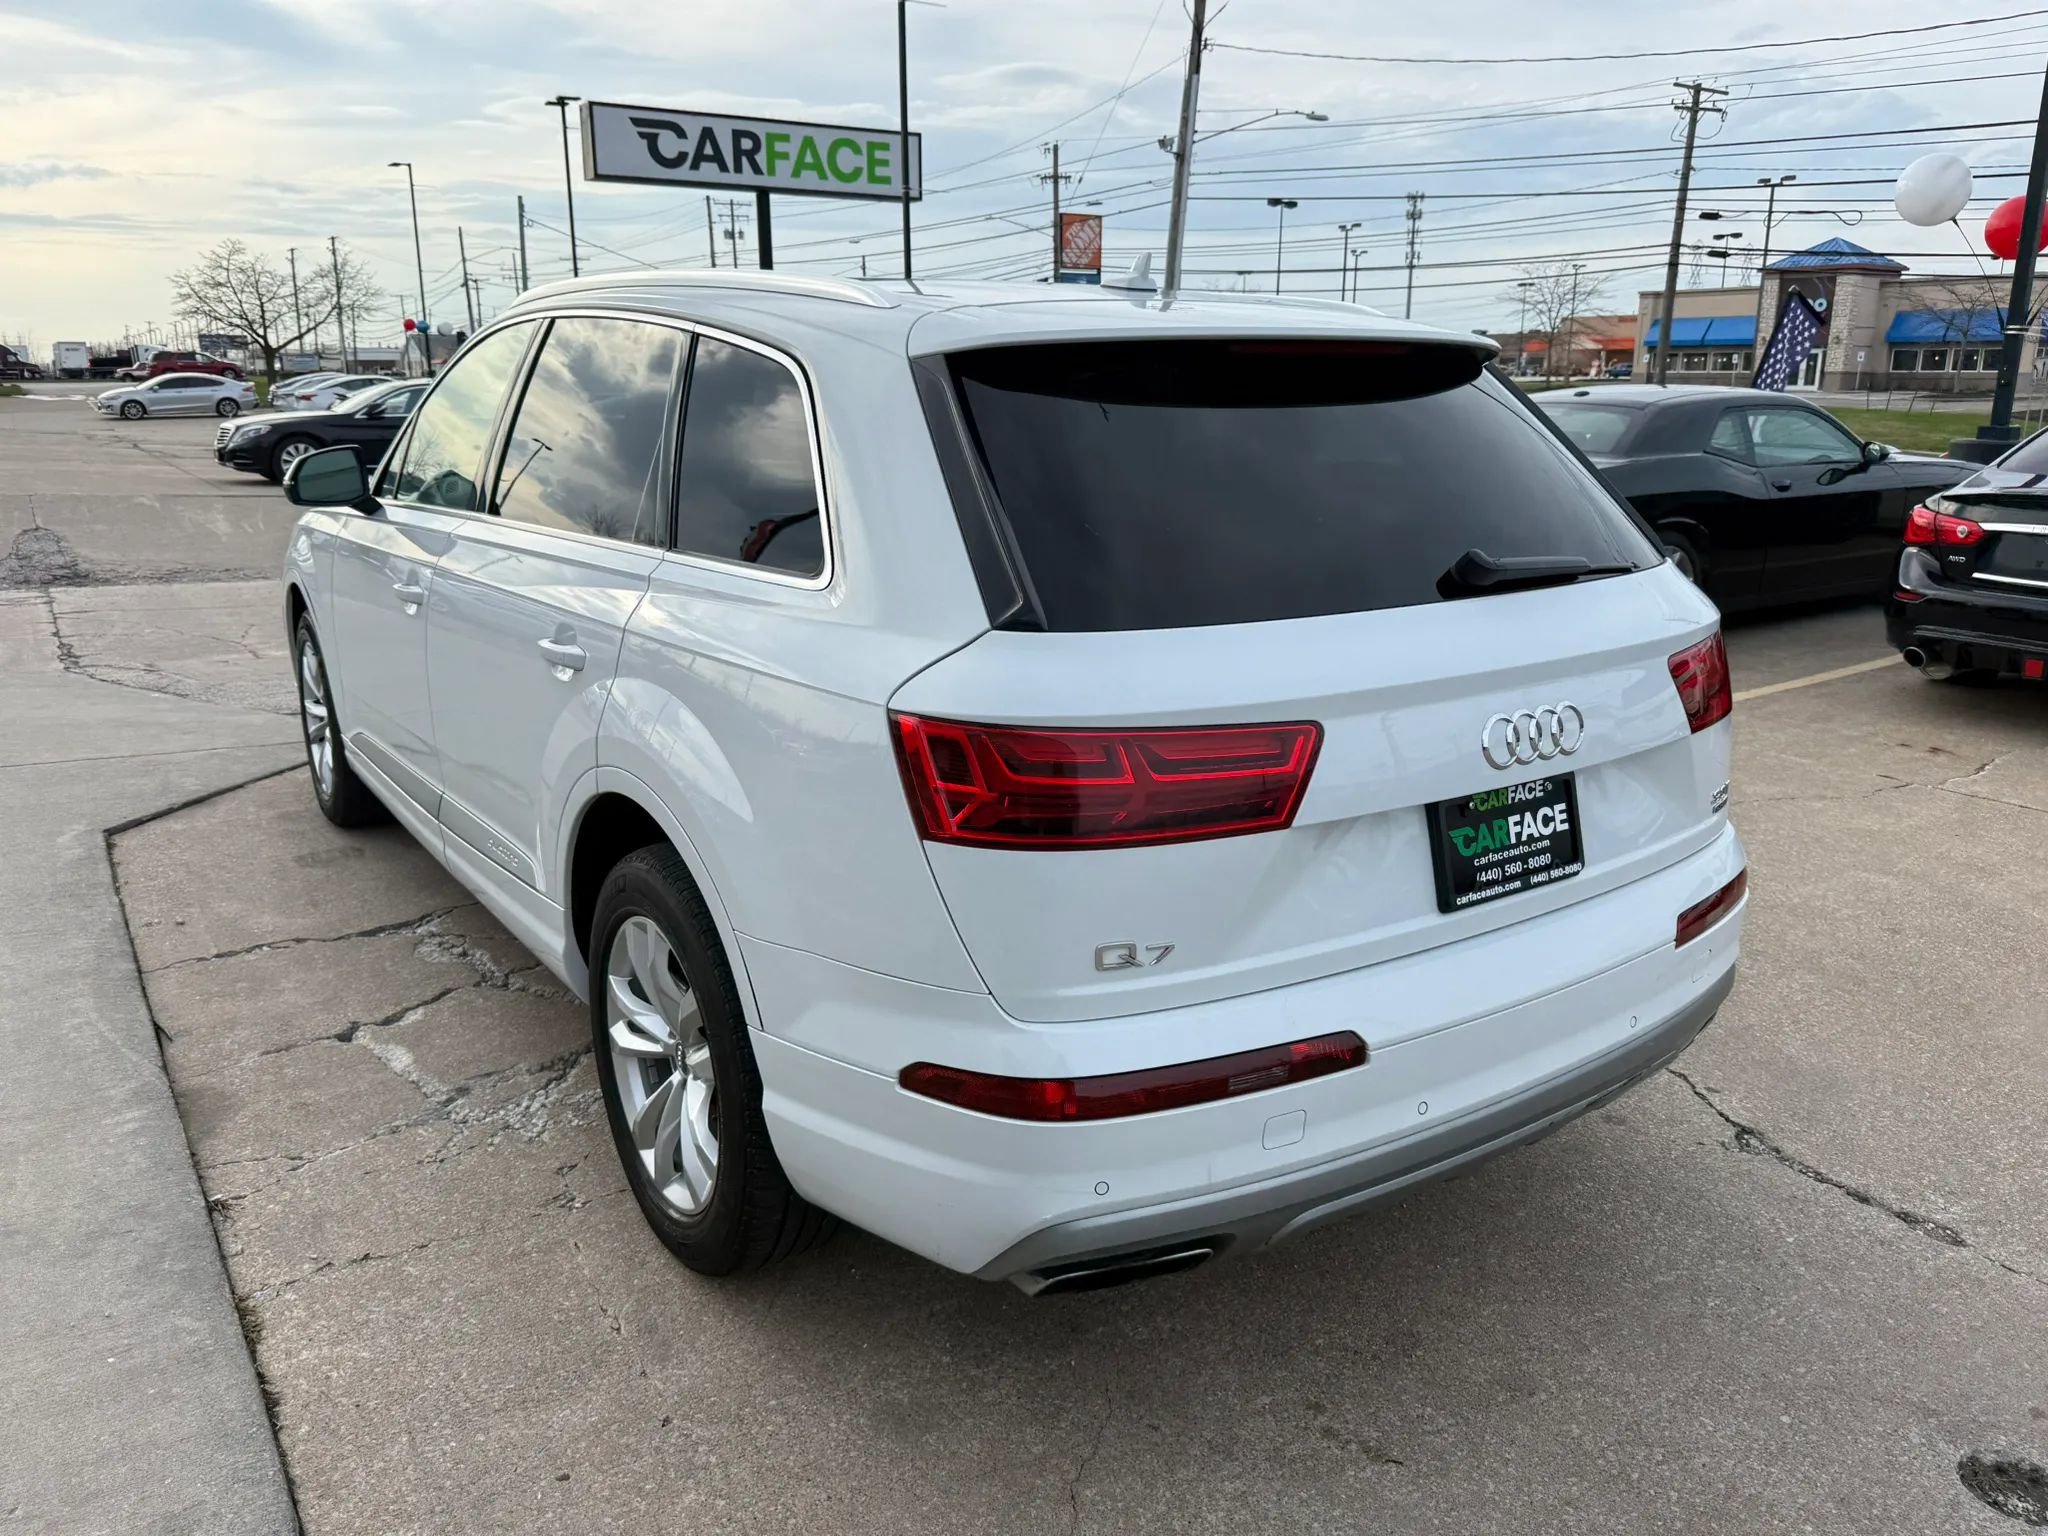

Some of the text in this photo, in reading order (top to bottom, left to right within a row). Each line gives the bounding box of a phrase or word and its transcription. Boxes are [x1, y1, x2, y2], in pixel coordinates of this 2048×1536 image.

[628, 116, 892, 186] CARFACE
[1472, 780, 1544, 812] CARFACE
[1448, 803, 1569, 857] CARFACE
[1474, 839, 1550, 866] carfaceauto.com
[1456, 862, 1583, 905] carfaceauto.com (440) 560-8080
[1476, 867, 1502, 883] (440)
